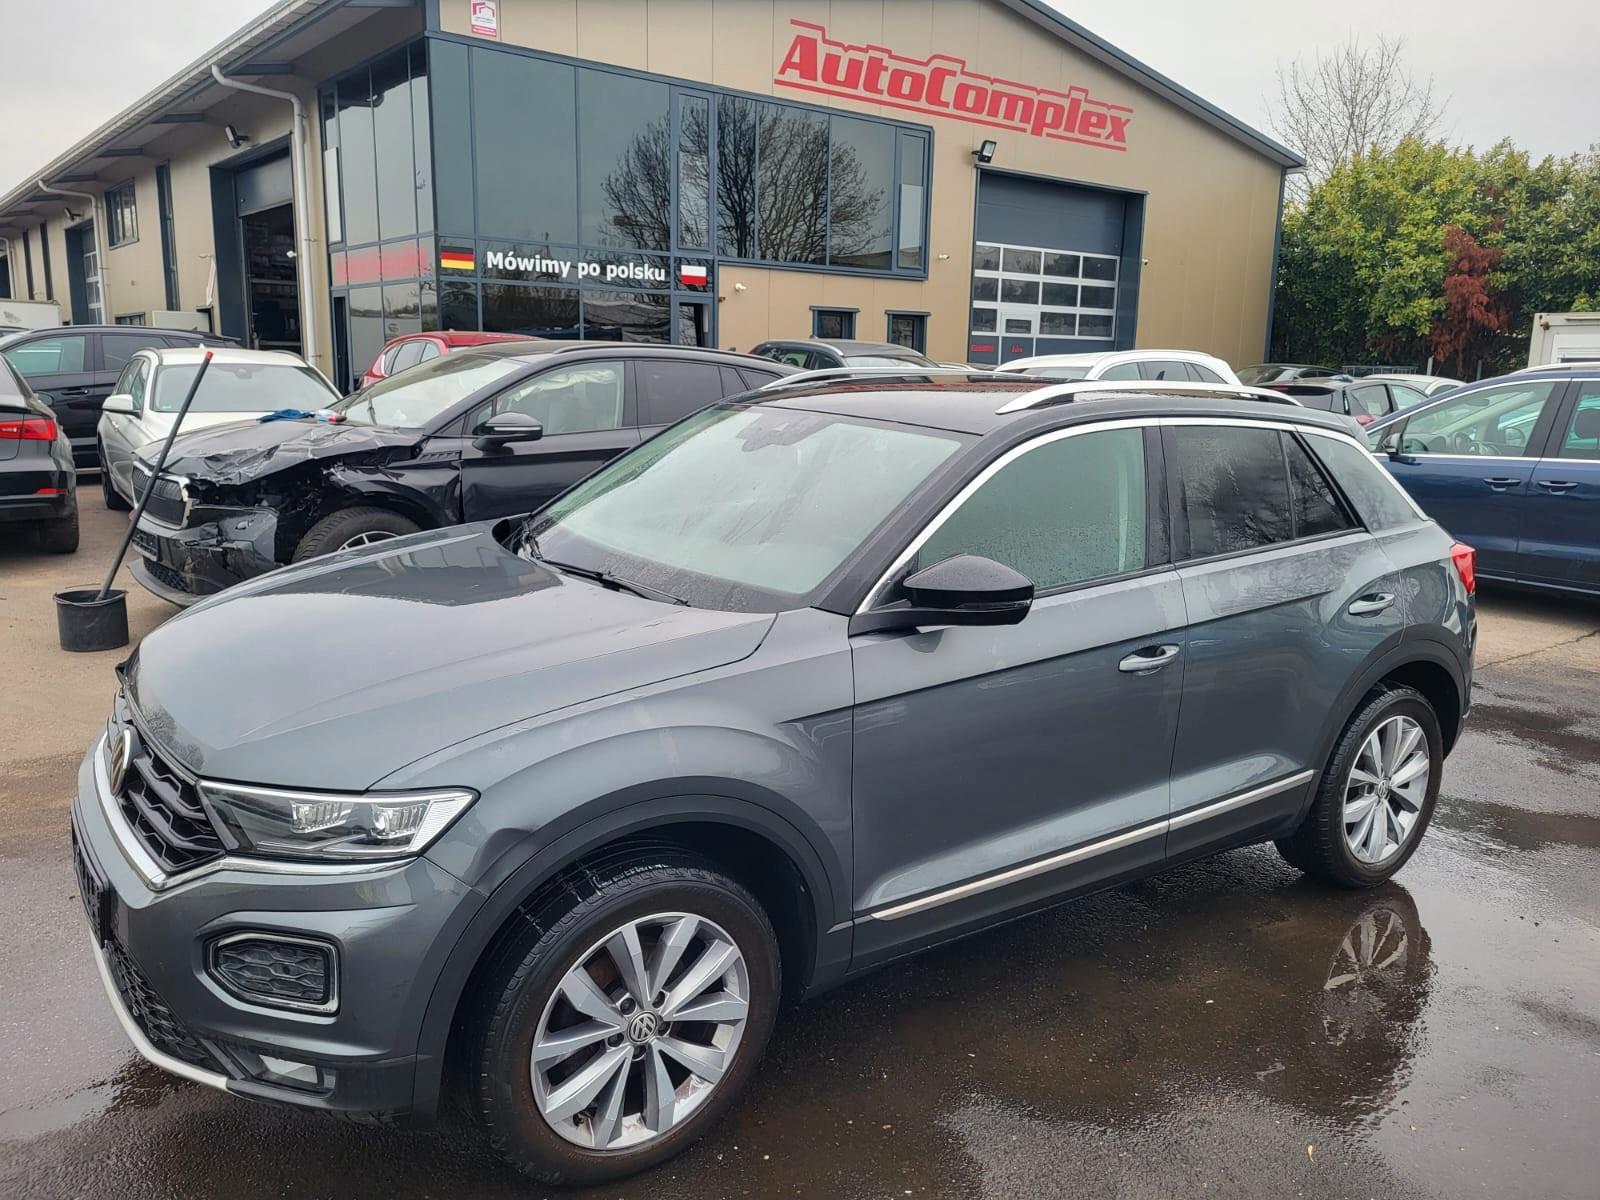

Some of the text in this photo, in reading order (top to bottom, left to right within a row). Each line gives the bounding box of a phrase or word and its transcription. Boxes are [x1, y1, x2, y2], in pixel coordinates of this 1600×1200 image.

[778, 34, 1132, 143] AutoComplex
[486, 250, 666, 282] Mówimy po polsku
